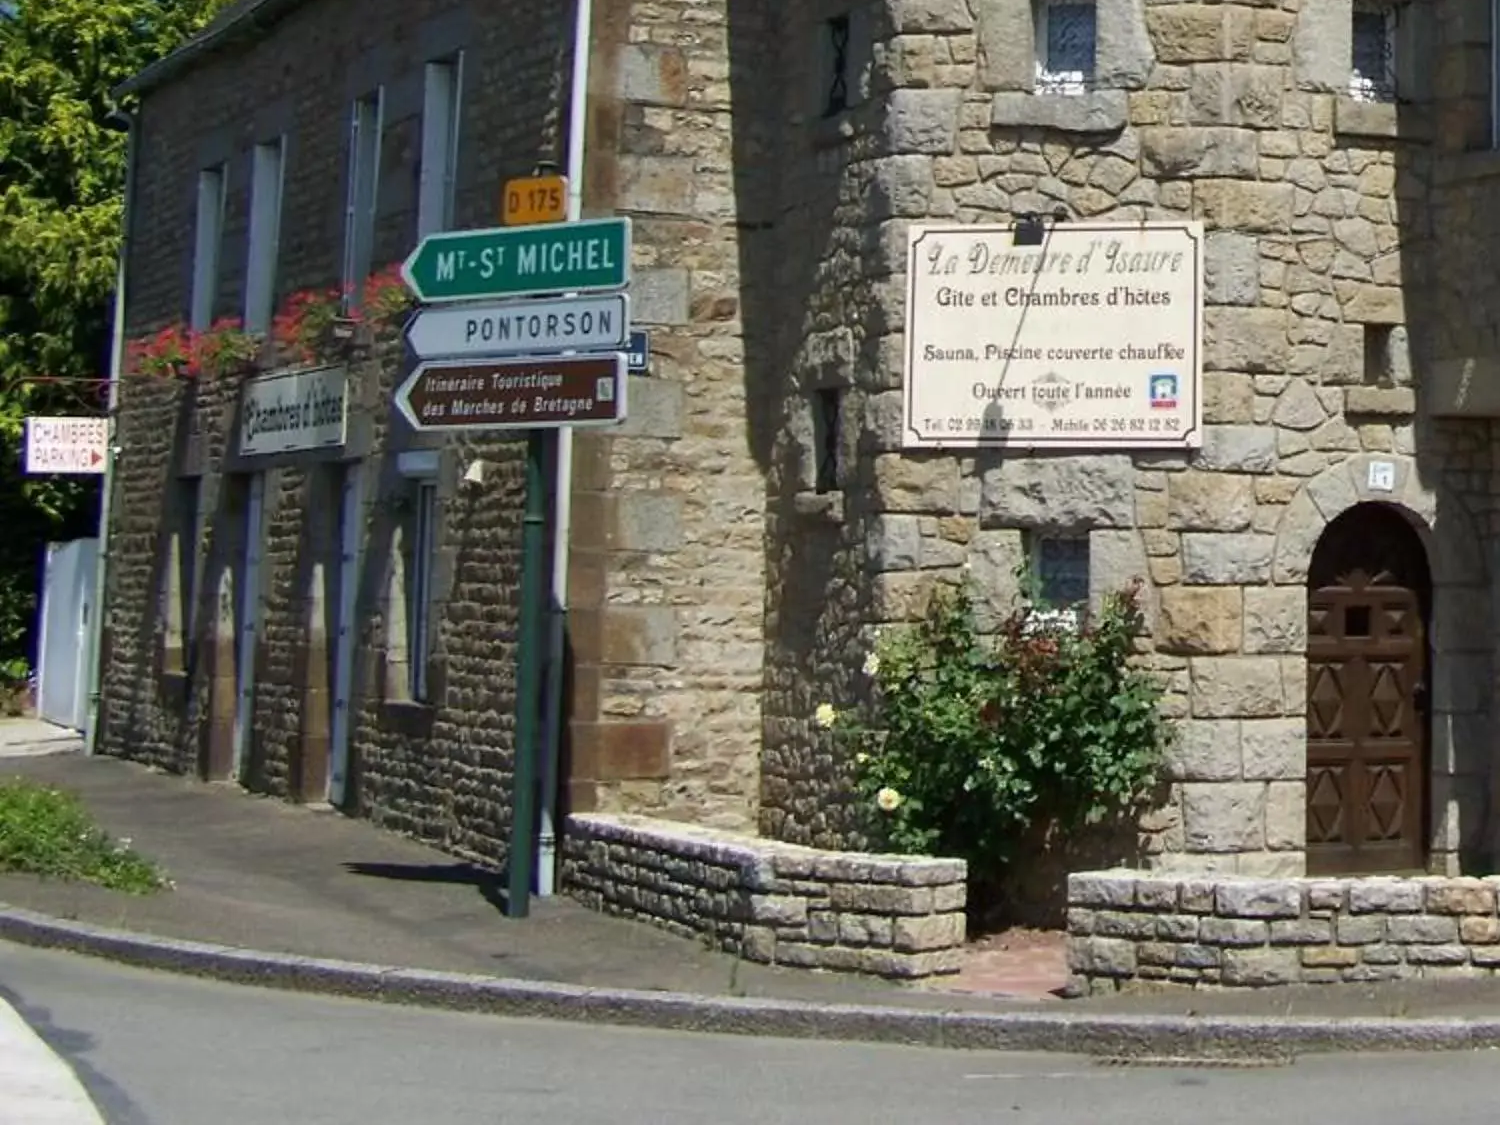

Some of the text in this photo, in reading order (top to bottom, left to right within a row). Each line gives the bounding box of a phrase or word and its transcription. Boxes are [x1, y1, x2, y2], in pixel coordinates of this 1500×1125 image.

[509, 189, 561, 214] D 175
[517, 238, 615, 276] MICHEL
[927, 241, 958, 276] La
[966, 241, 1073, 276] Demeure
[981, 288, 998, 307] et
[1004, 286, 1099, 307] Chambres
[1106, 285, 1171, 307] d'hôtes
[465, 310, 612, 343] PONTORSON
[923, 344, 979, 362] Sauna,
[985, 343, 1041, 361] Piscine
[1047, 346, 1113, 361] couverte
[492, 371, 562, 391] Touristique
[972, 381, 1132, 401] Ouvert toute l'année
[422, 395, 593, 417] des Marches de Bretagne
[35, 423, 103, 444] CHAMBRES
[35, 447, 88, 467] PARKING
